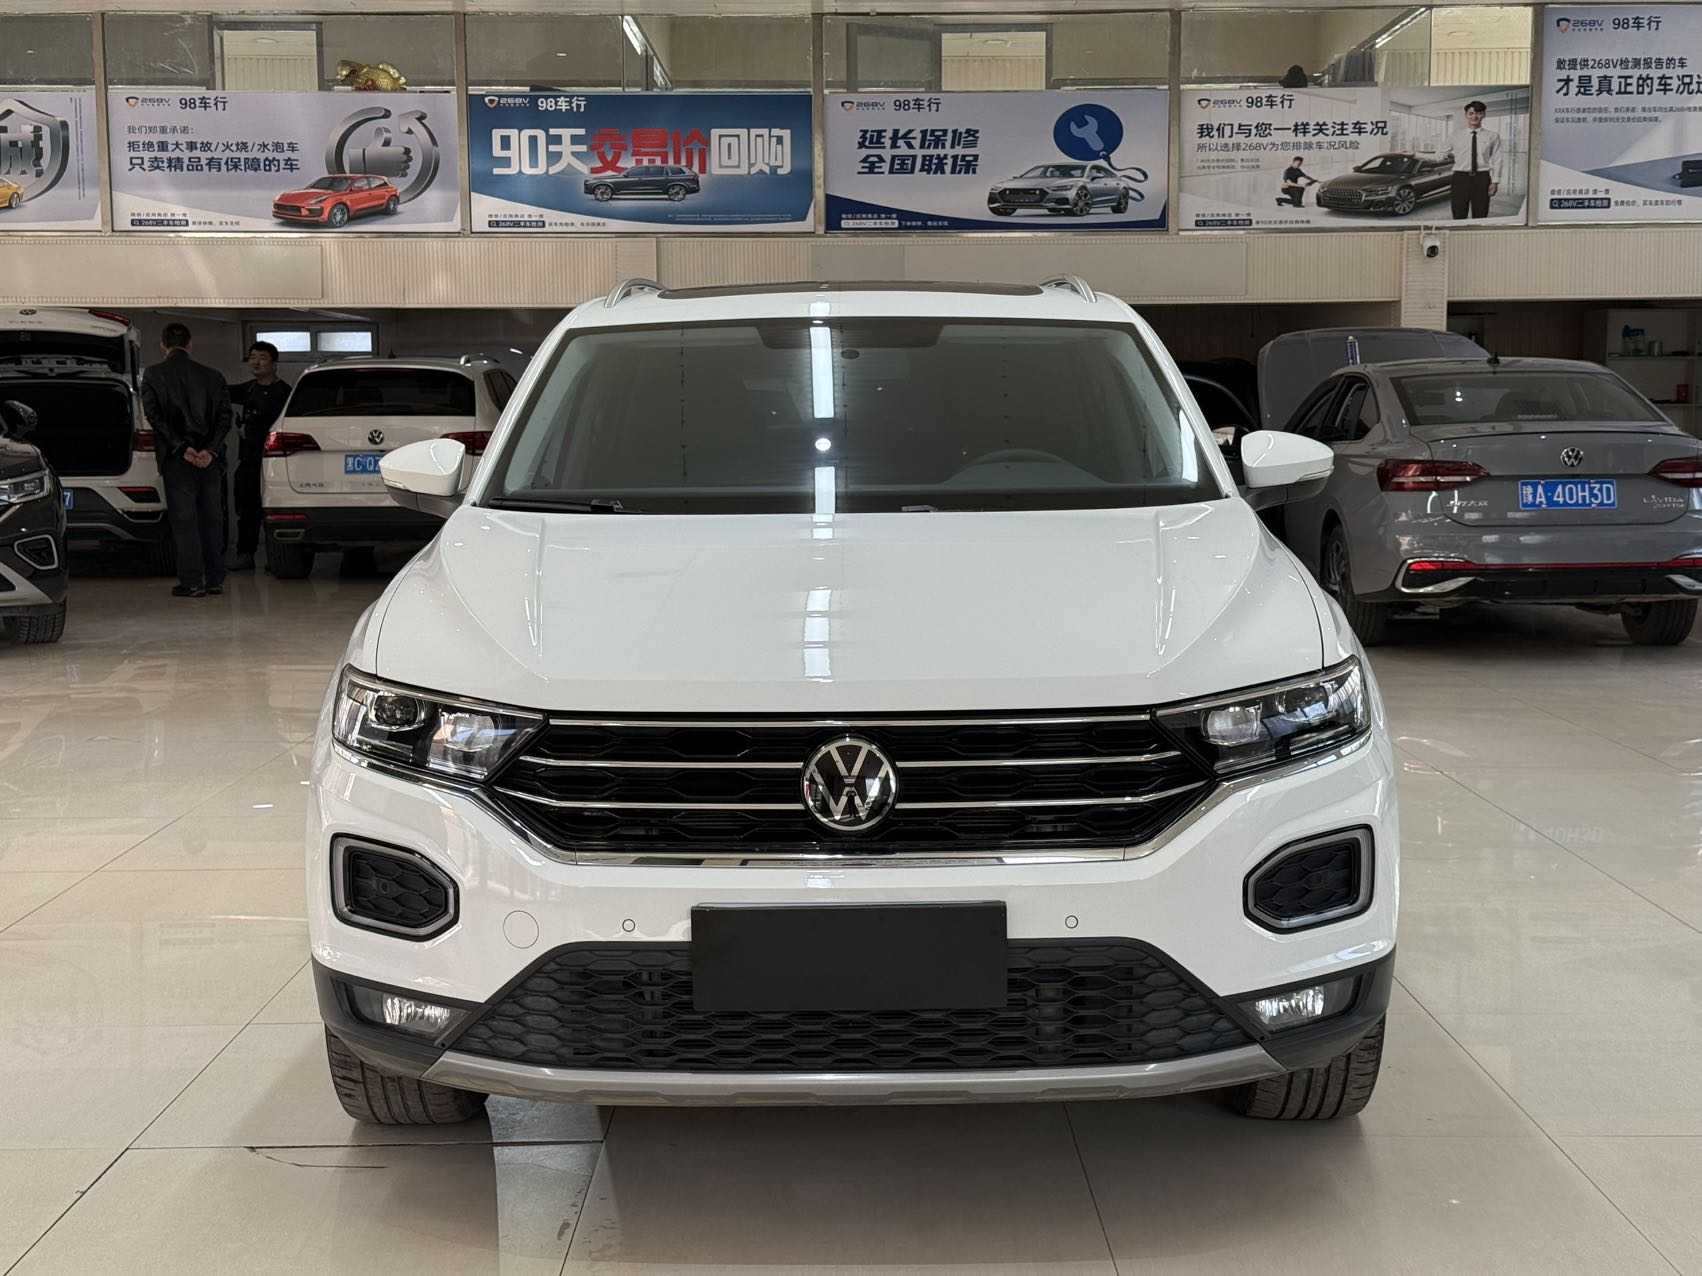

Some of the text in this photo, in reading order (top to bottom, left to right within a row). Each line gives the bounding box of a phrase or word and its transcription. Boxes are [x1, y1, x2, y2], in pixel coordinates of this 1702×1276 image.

[1612, 16, 1662, 31] 98车行
[179, 96, 229, 112] 98车行
[537, 96, 587, 112] 98车行
[893, 97, 942, 113] 98车行
[1246, 94, 1295, 110] 98车行
[1196, 121, 1389, 139] 我们与您一样关注车况
[127, 141, 300, 153] 拒绝重大事故/火烧/水泡车
[857, 128, 980, 150] 延长保修
[128, 156, 300, 173] 只卖精品有保障的车
[857, 153, 980, 175] 全国联保
